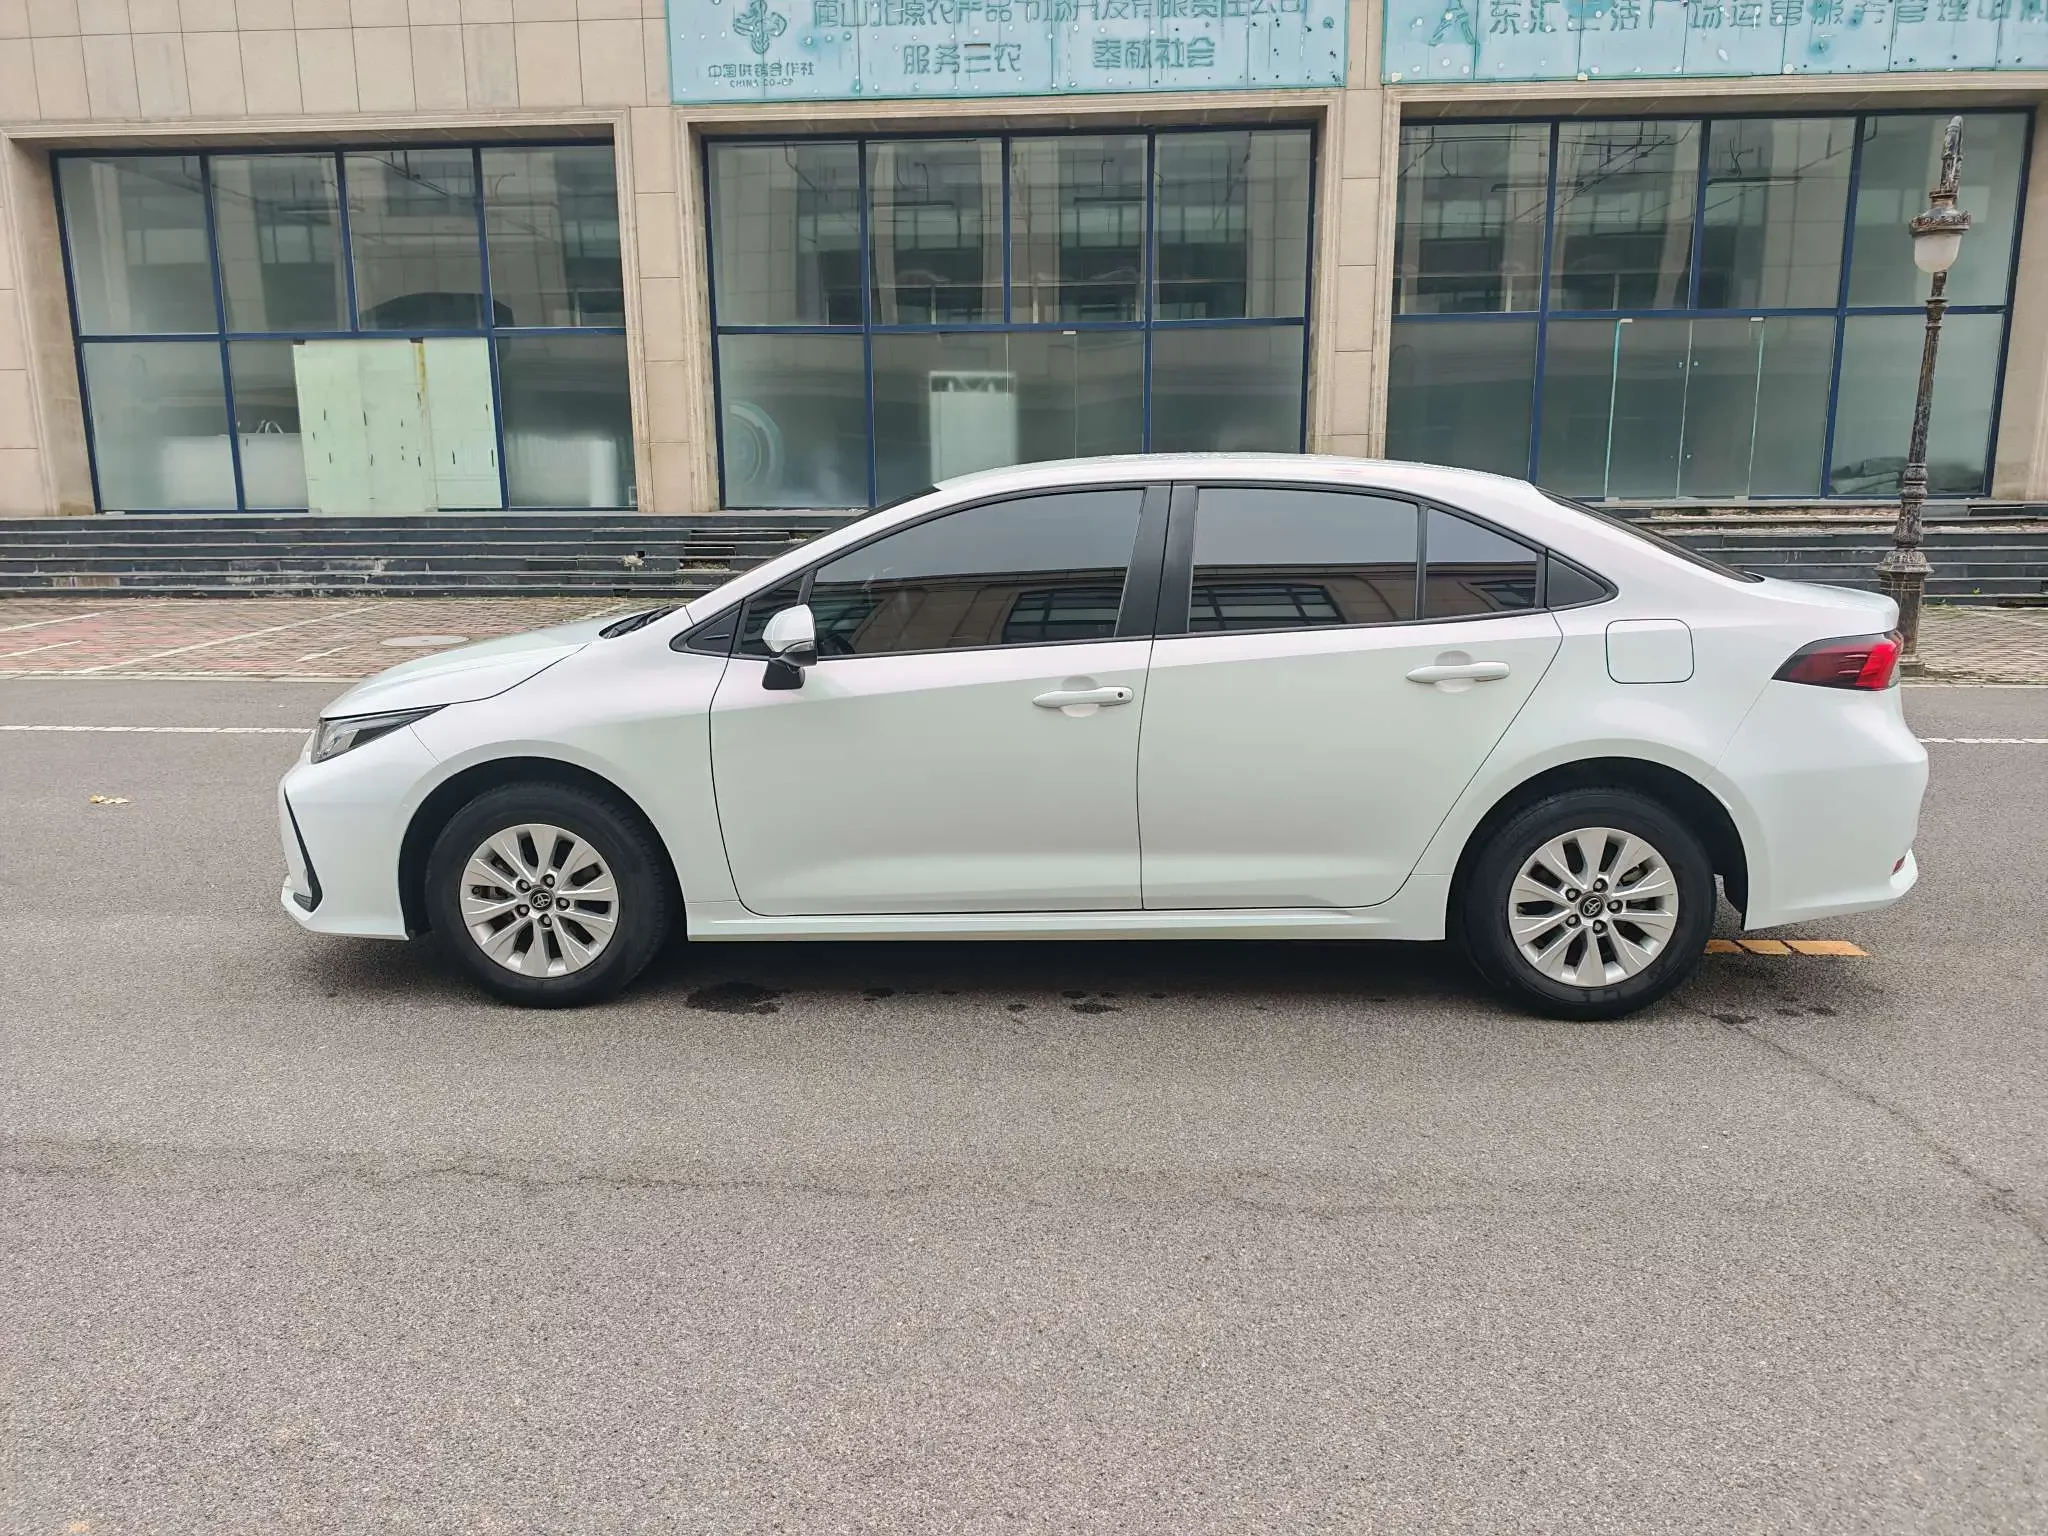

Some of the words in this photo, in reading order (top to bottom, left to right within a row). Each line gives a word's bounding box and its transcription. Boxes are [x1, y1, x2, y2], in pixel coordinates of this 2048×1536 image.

[903, 43, 1021, 74] 服务三农
[1093, 37, 1216, 69] 奉献社会
[708, 61, 815, 78] 中国供销合作社
[729, 79, 759, 88] CHINA
